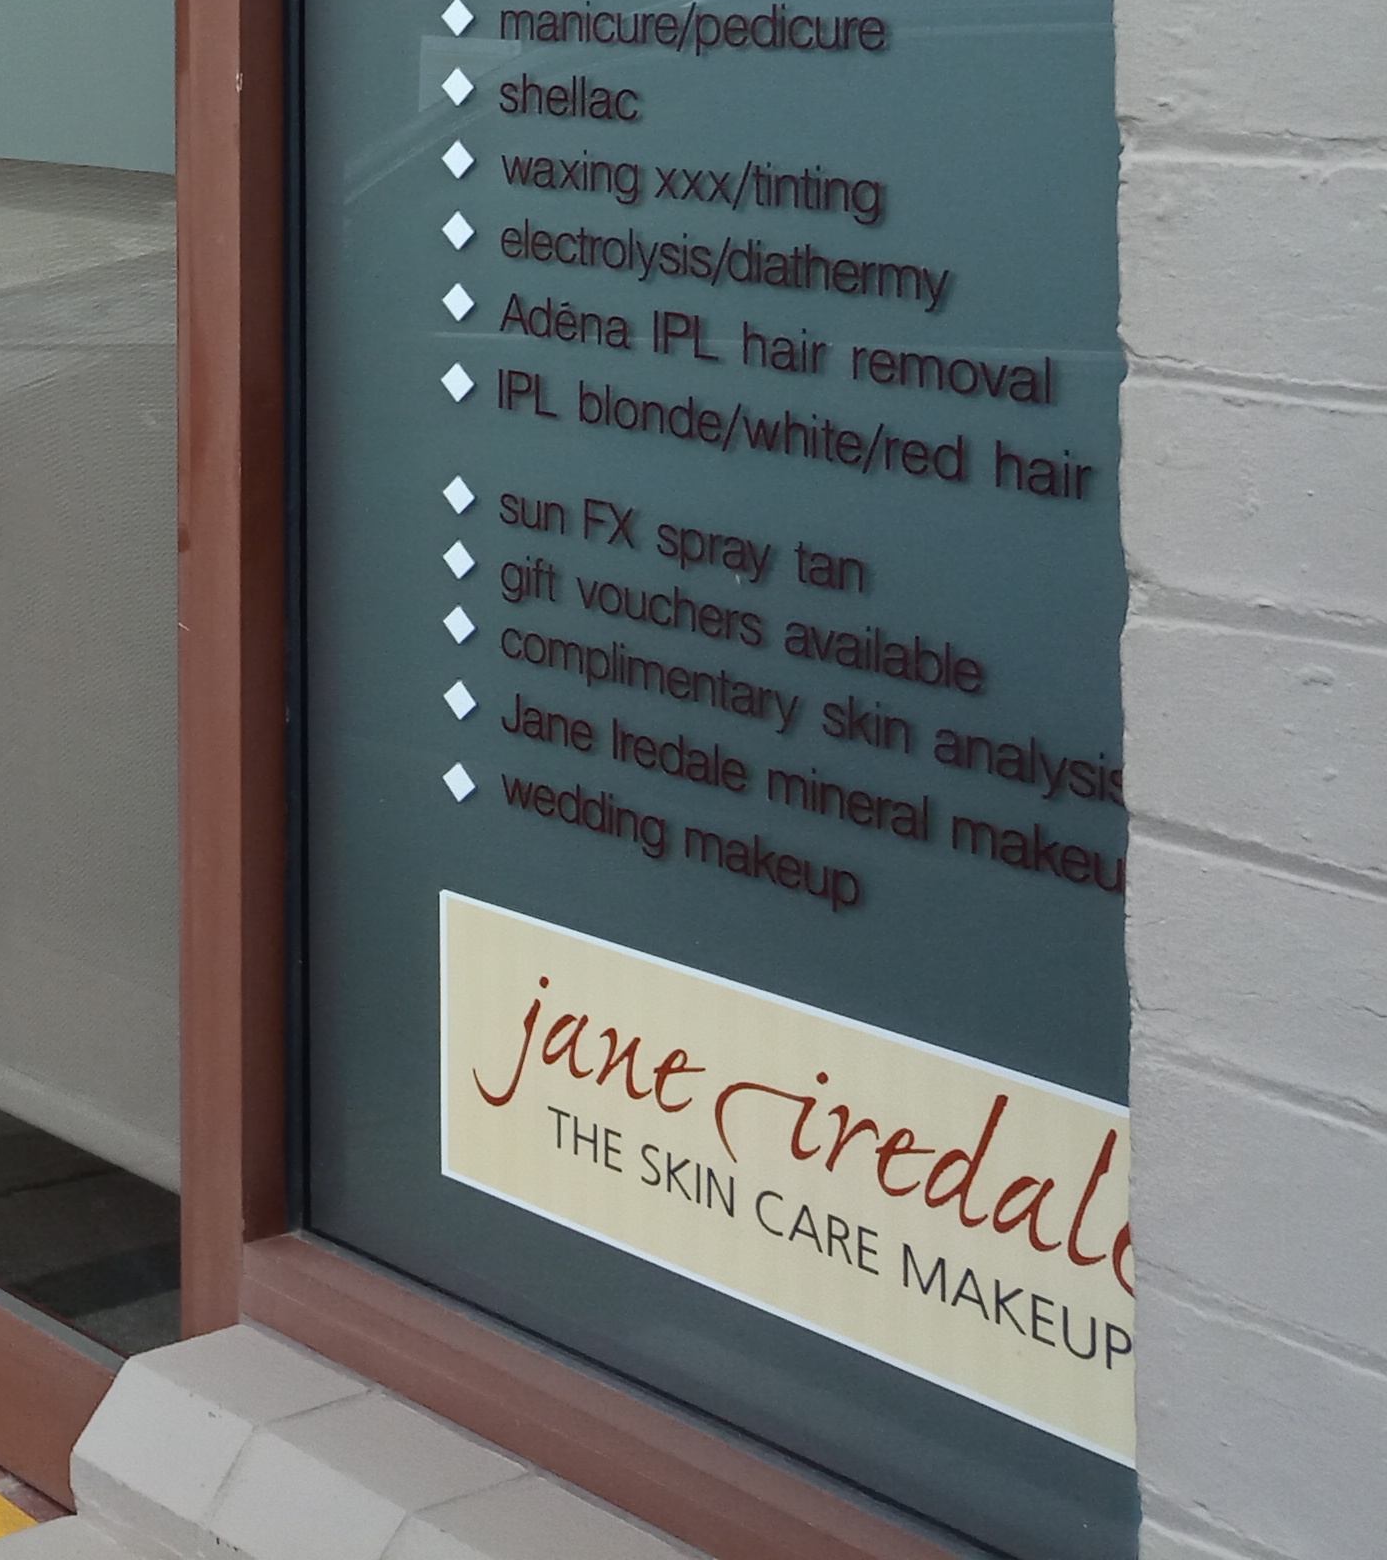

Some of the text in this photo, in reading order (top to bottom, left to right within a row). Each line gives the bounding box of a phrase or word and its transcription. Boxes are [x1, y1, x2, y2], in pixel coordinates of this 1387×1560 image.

[500, 0, 888, 56] manicure/pedicure
[499, 75, 640, 122] shellac
[502, 151, 883, 225] waxing xxx/tinting
[500, 219, 950, 313] electrolysis/diathermy
[500, 294, 1055, 406] Adéna IPL hair removal
[497, 369, 1092, 500] IPL blonde/white/red hair
[499, 491, 865, 593] sun FX spray tan
[501, 556, 985, 695] gift vouchers available
[501, 626, 799, 734] complimentary
[822, 696, 912, 752] skin
[501, 693, 593, 752] Jane
[612, 717, 748, 793] Iredale
[767, 765, 930, 840] mineral
[502, 771, 861, 912] wedding makeup
[472, 976, 705, 1108] jane
[548, 1105, 1132, 1370] THE SKIN CARE MAKEUP
